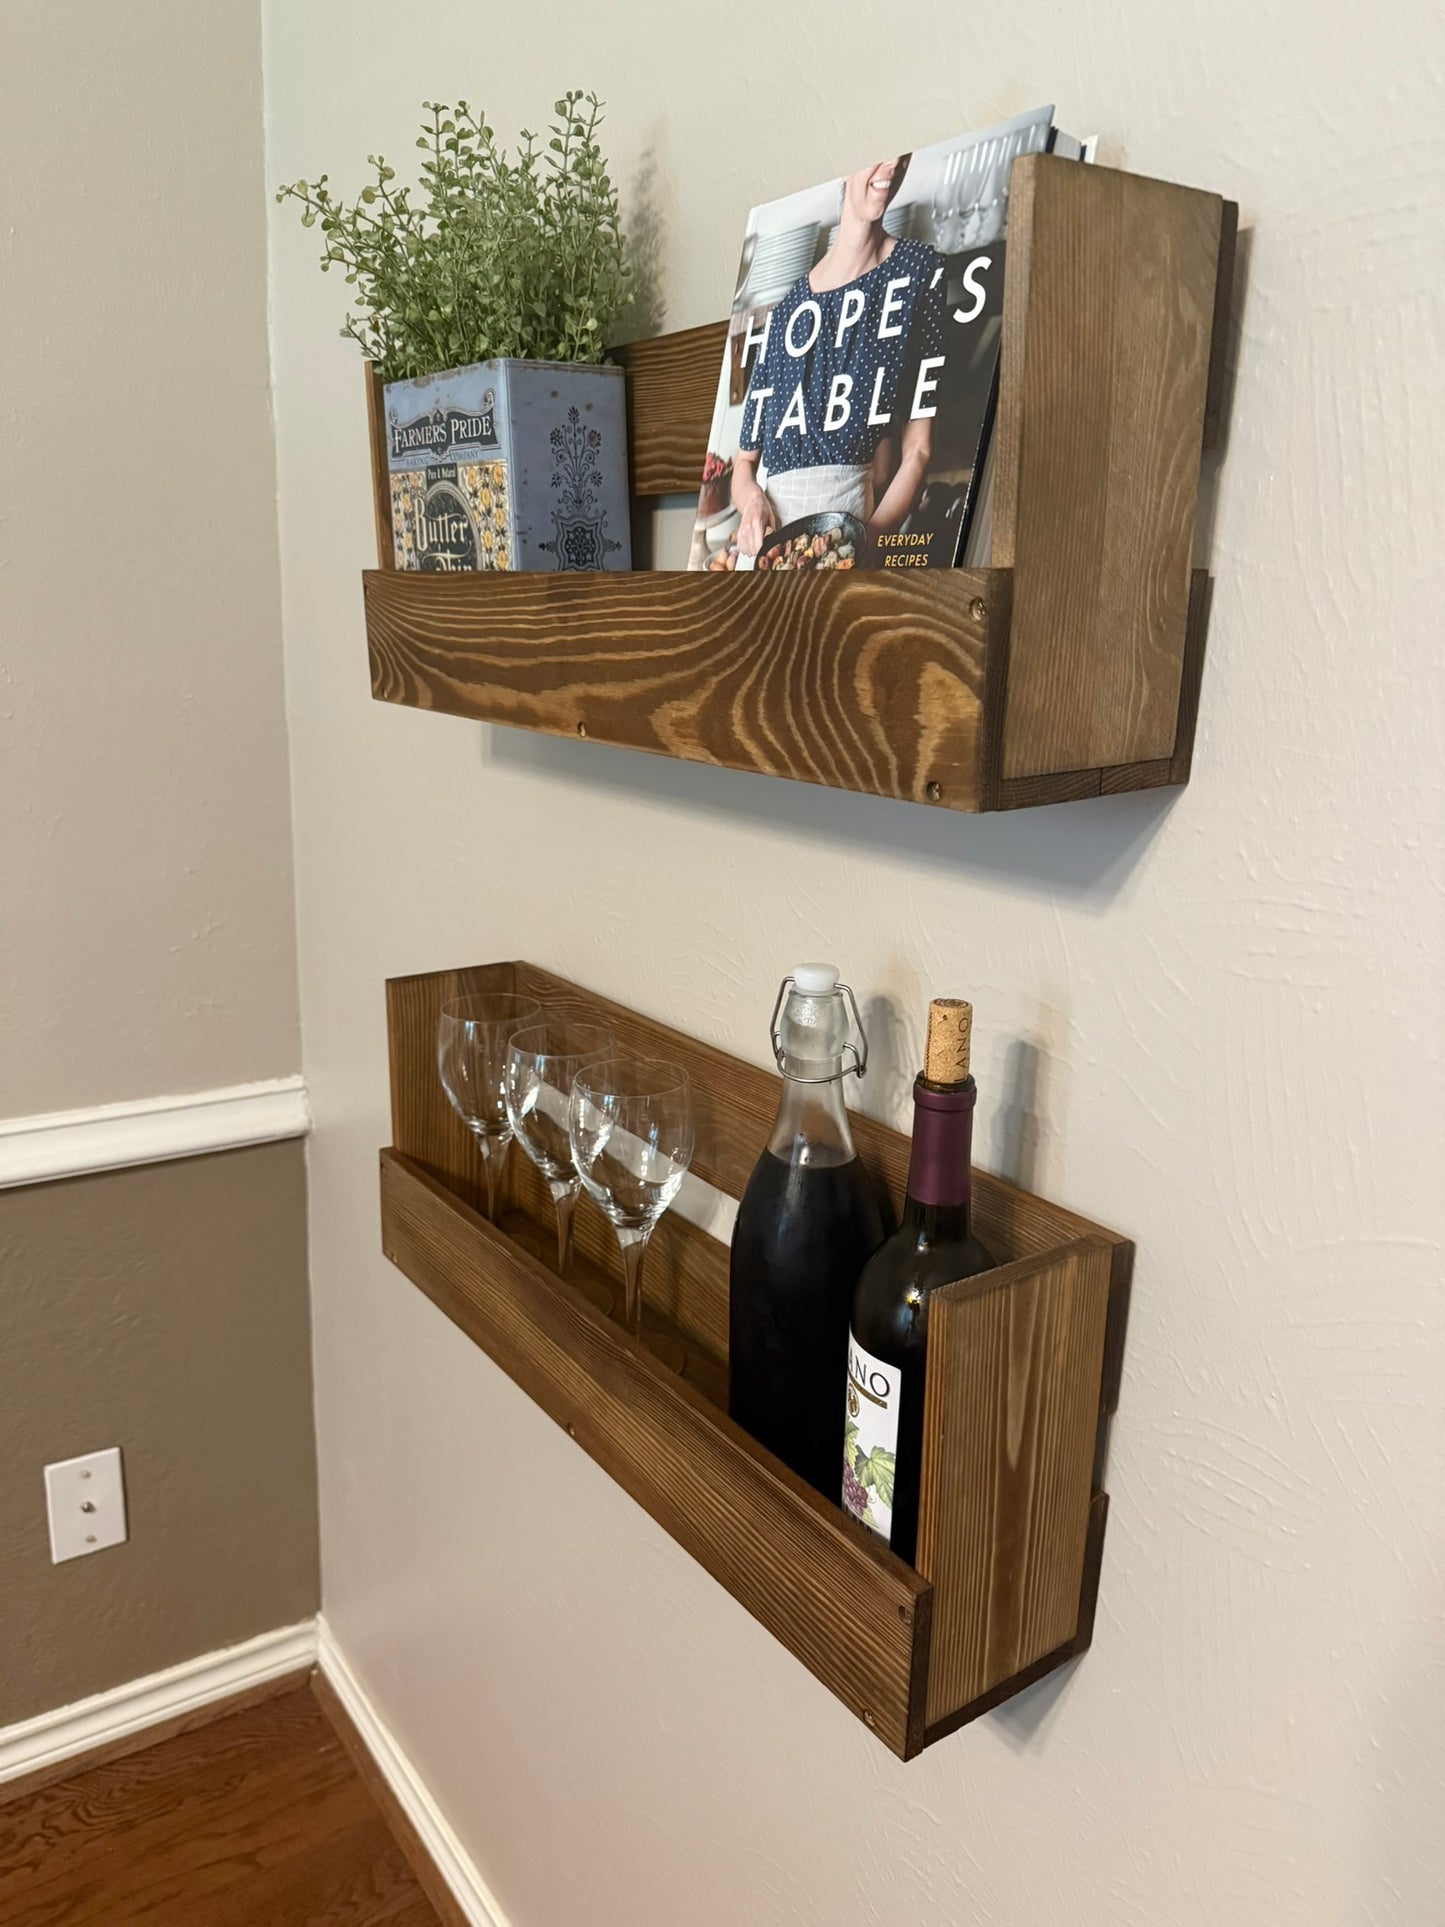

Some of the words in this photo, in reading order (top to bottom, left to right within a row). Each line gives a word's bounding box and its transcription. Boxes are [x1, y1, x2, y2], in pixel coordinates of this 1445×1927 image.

[740, 256, 993, 369] HOPE'S
[749, 355, 946, 444] TABLE
[394, 424, 447, 453] FARMERS
[451, 416, 491, 444] PRIDE
[414, 497, 469, 552] Butter
[877, 532, 934, 547] EVERYDAY
[884, 553, 929, 568] RECIPES
